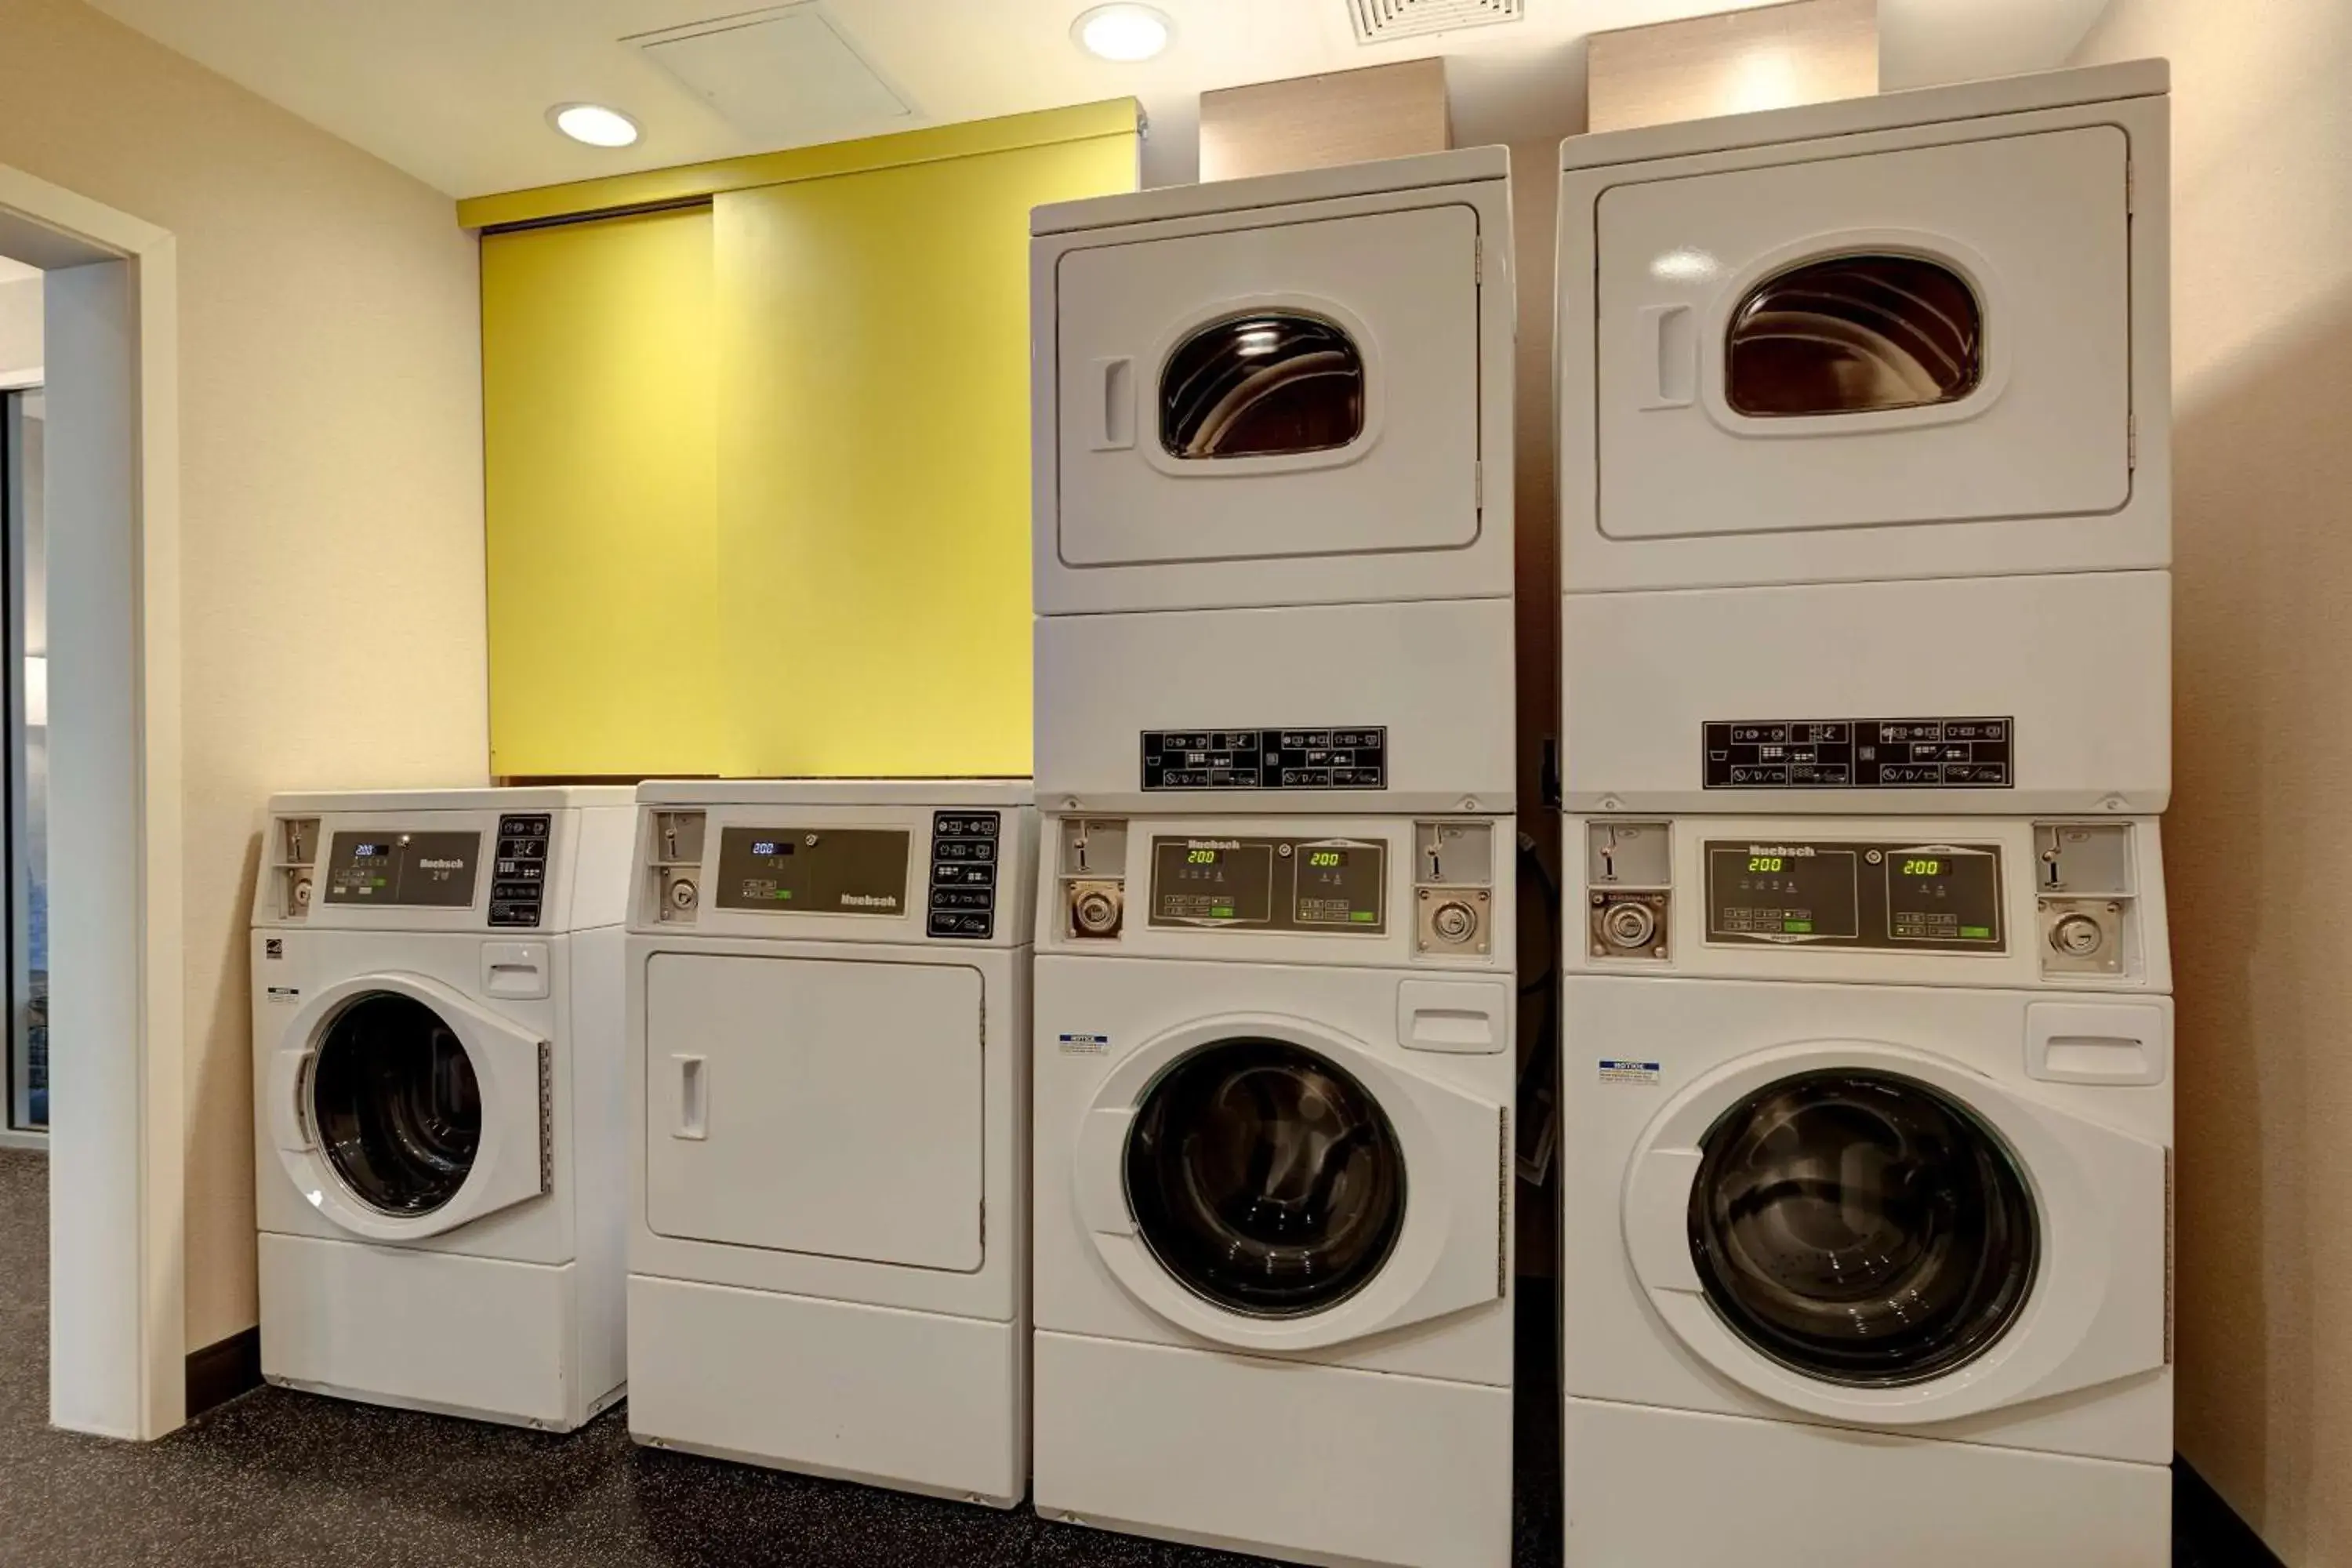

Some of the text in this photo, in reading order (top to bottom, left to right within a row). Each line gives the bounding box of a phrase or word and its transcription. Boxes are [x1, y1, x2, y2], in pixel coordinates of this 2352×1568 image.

[1188, 851, 1215, 863] 200
[1748, 844, 1816, 856] Huebsch
[1310, 852, 1339, 866] 200
[1748, 858, 1782, 872] 200
[1904, 860, 1939, 875] 200
